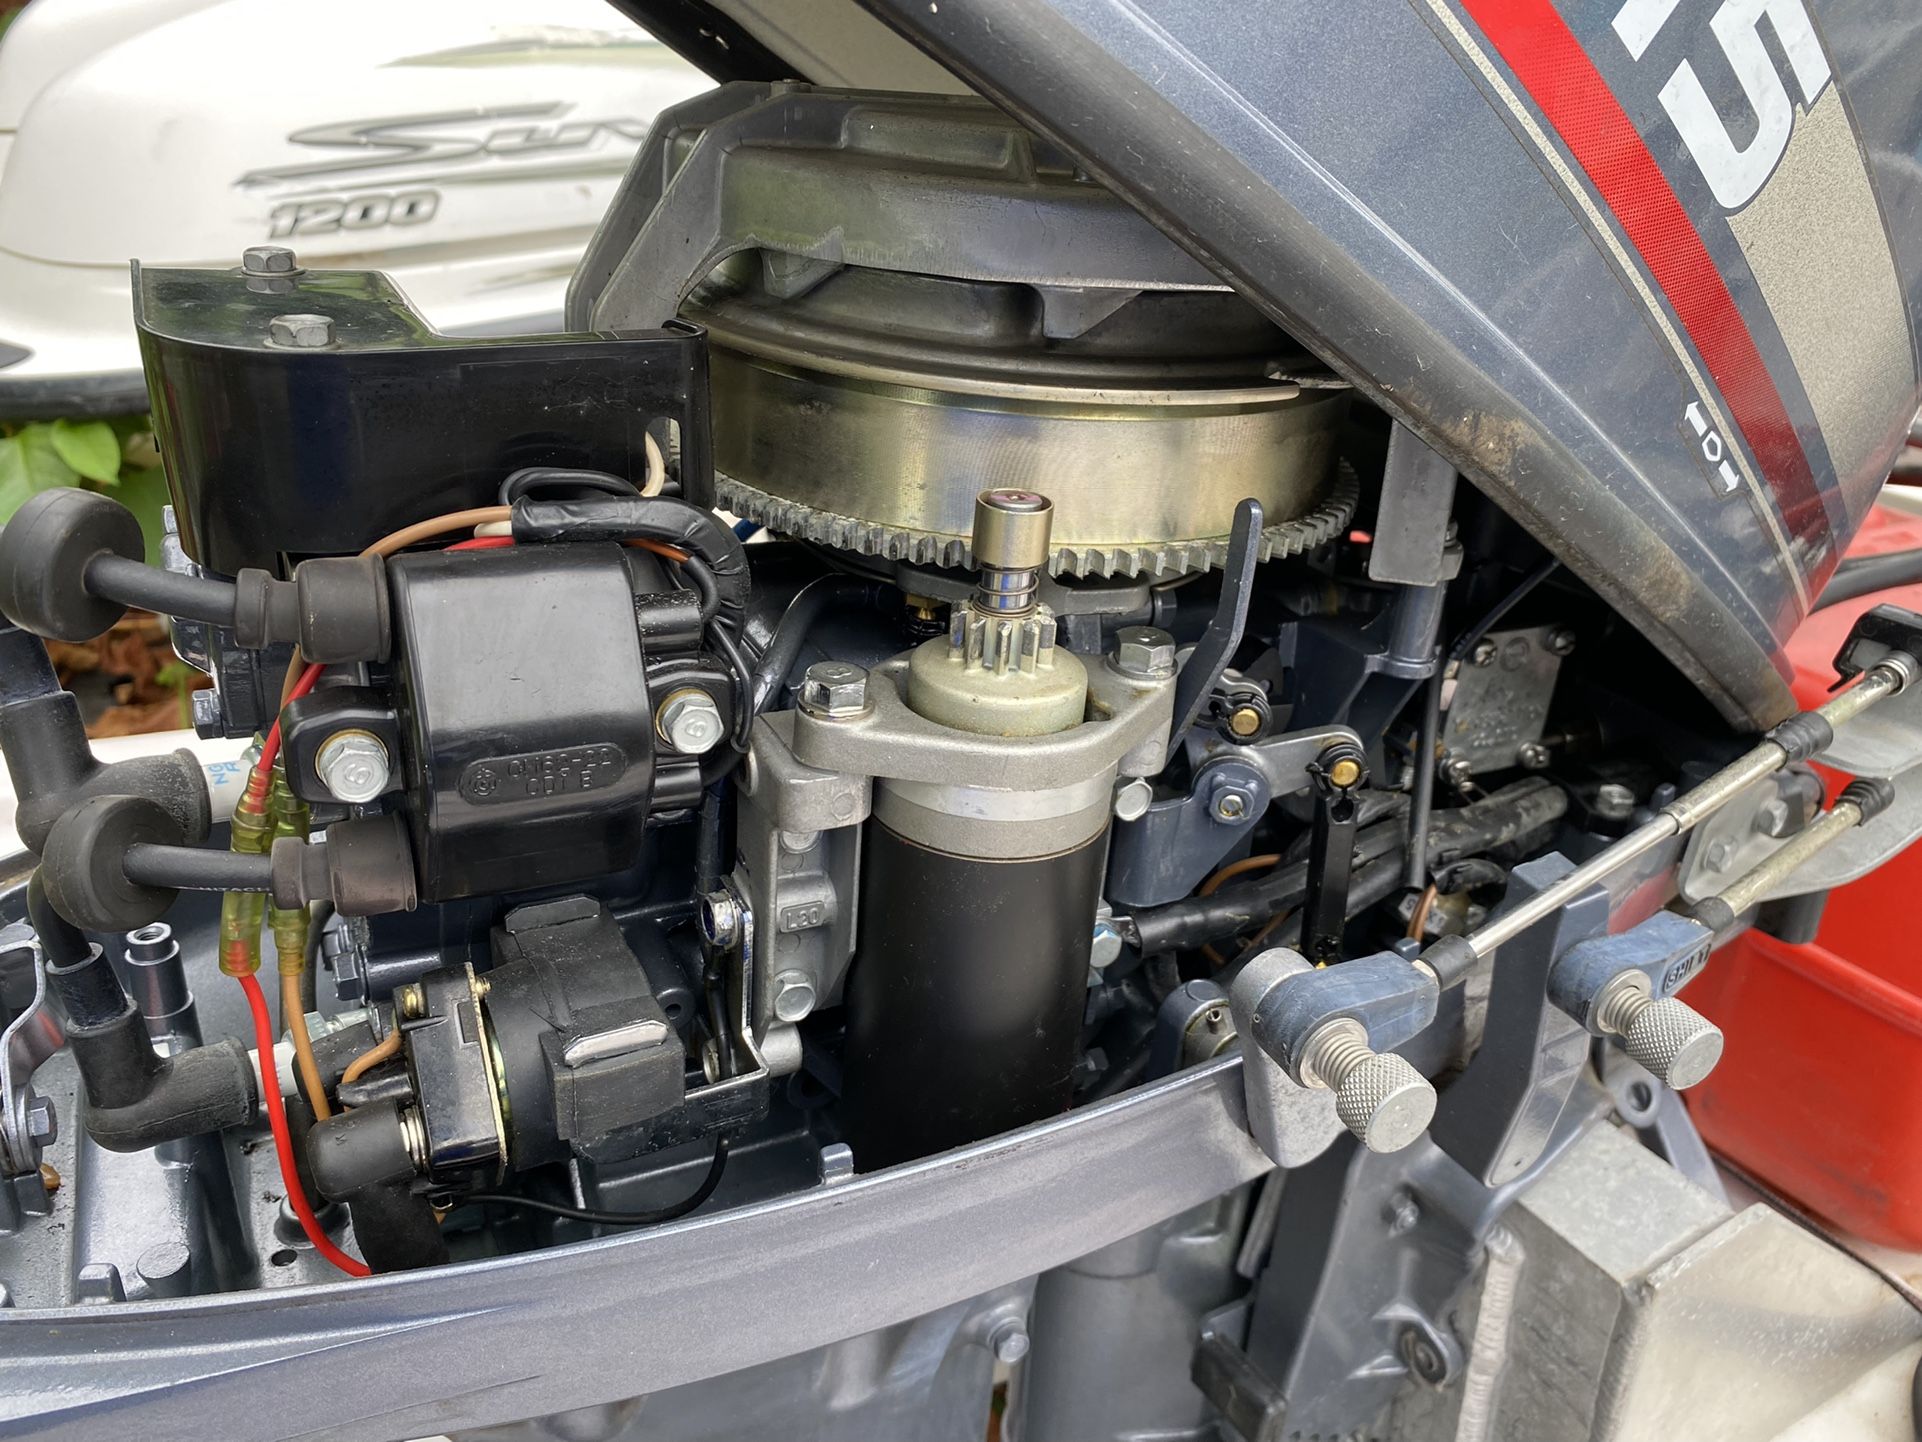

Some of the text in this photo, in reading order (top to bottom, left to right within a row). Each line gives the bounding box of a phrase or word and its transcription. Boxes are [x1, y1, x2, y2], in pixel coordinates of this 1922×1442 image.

[1611, 0, 1831, 209] 5
[268, 188, 441, 239] 1200
[786, 907, 819, 930] L20
